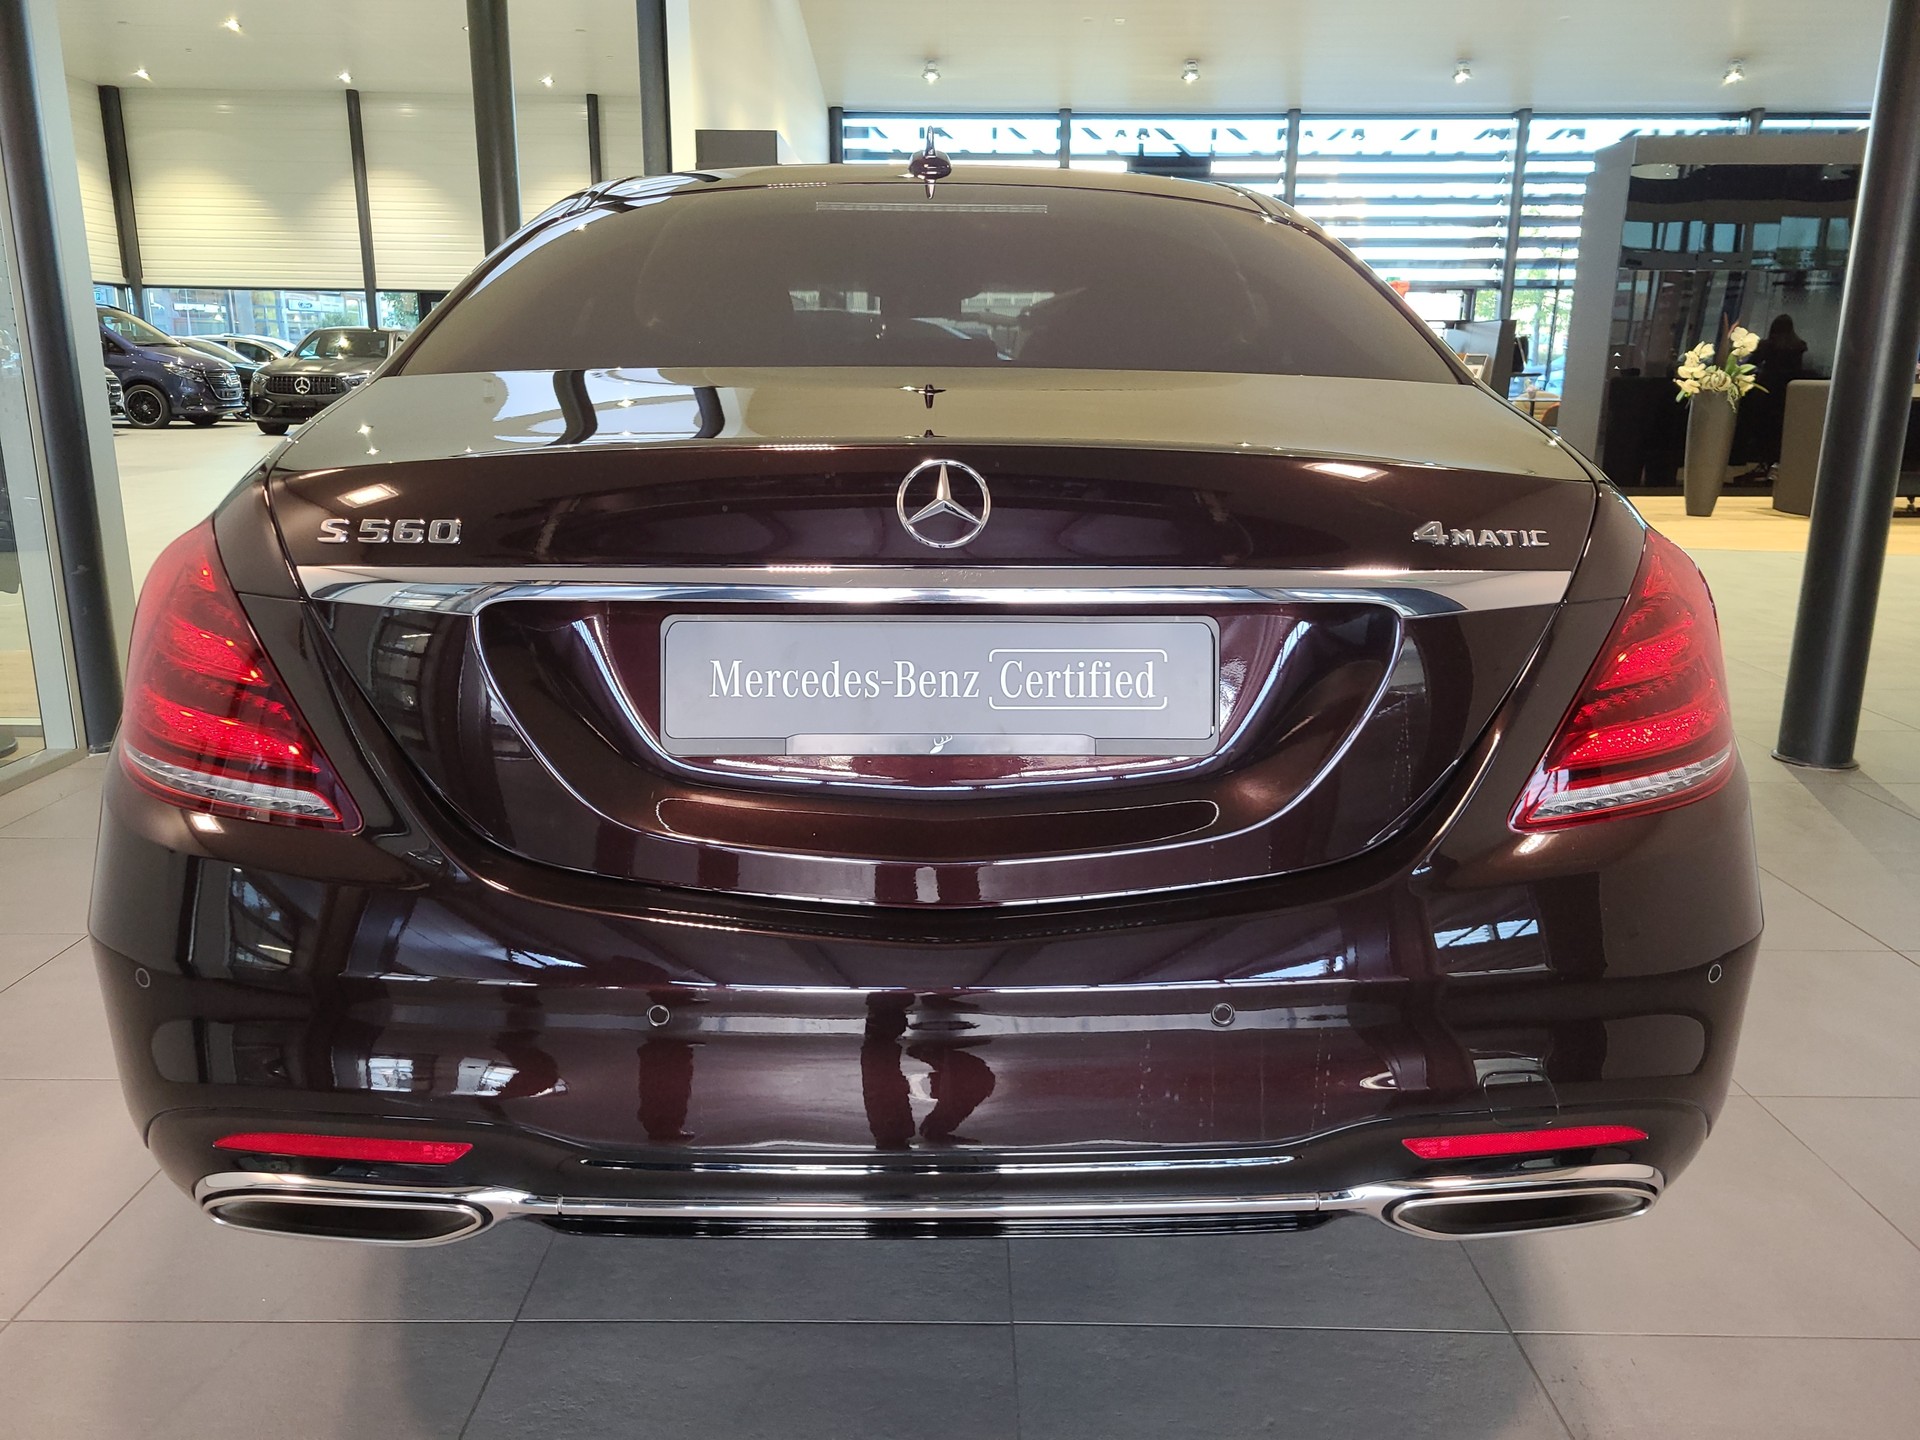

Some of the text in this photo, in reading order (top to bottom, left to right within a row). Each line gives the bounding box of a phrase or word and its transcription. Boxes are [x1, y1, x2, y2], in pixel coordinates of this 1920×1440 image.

[317, 518, 462, 544] S 560
[1411, 520, 1550, 547] 4MATIC
[709, 659, 1156, 698] Mercedes-Benz Certified
